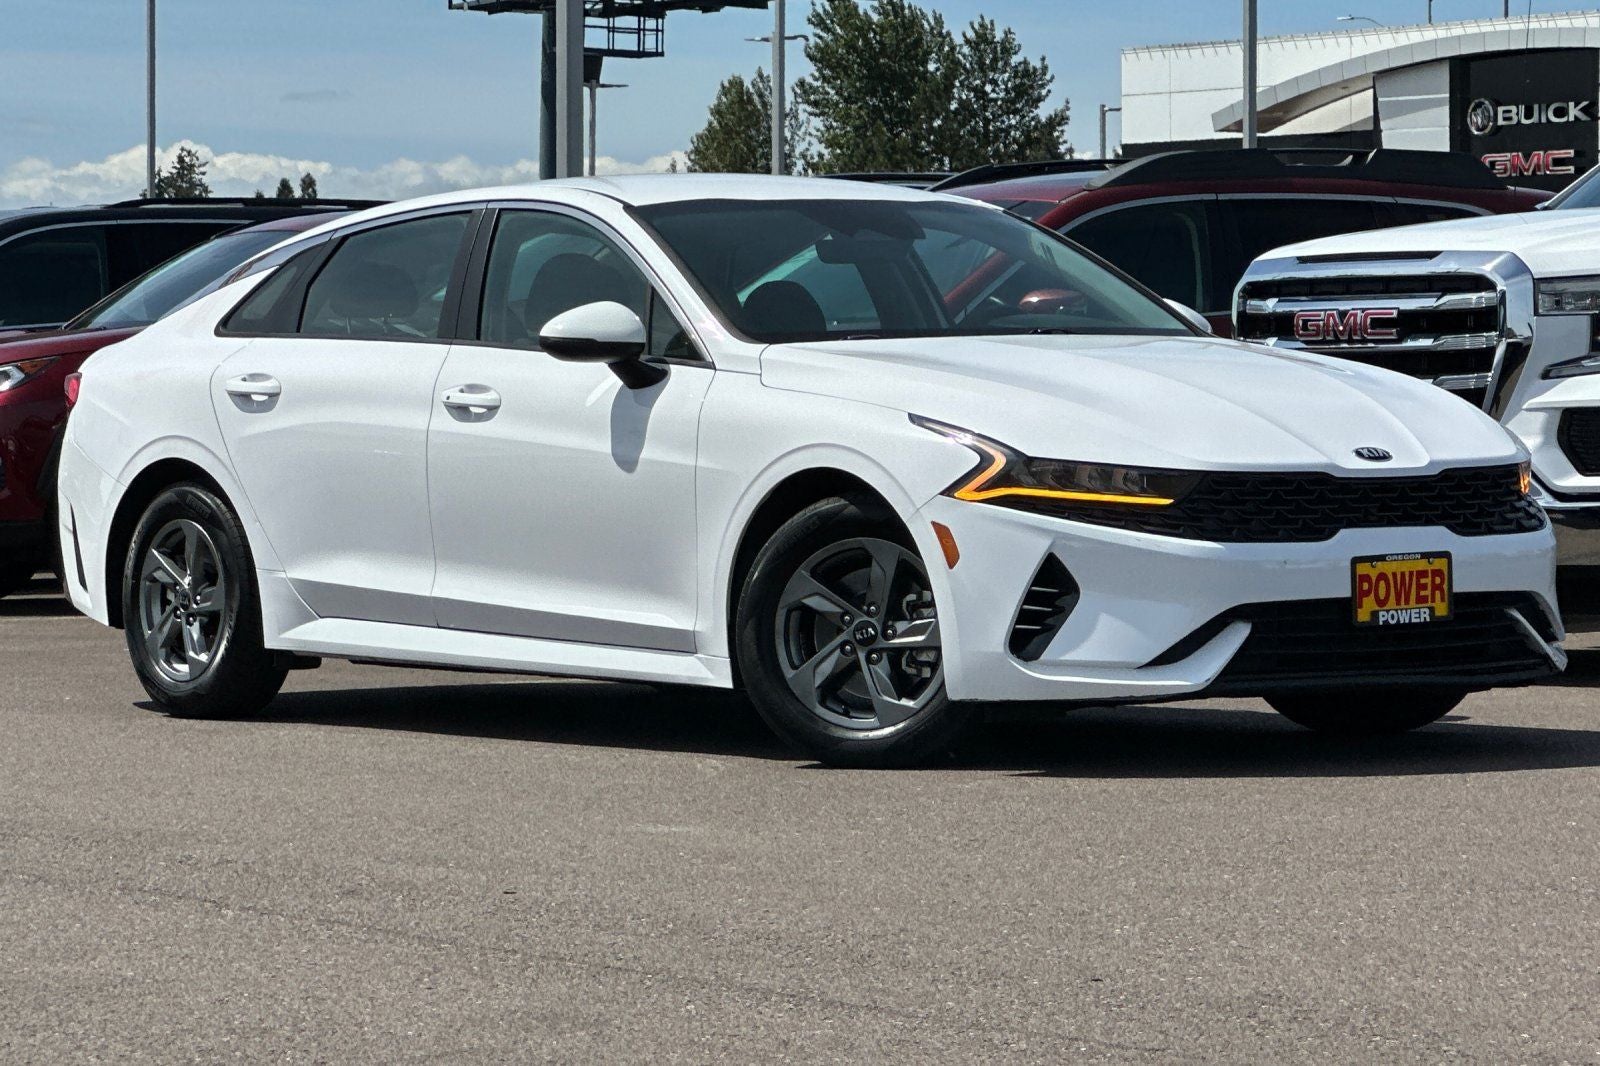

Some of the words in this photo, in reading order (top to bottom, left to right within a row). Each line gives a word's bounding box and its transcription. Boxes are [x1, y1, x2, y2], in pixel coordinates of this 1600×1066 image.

[1497, 101, 1592, 126] BUICK
[1481, 149, 1575, 178] GMC
[1294, 309, 1399, 341] GMC
[1386, 553, 1421, 561] OREGON
[1357, 568, 1446, 609] POWER
[1378, 607, 1430, 626] POWER
[855, 627, 876, 640] KIA
